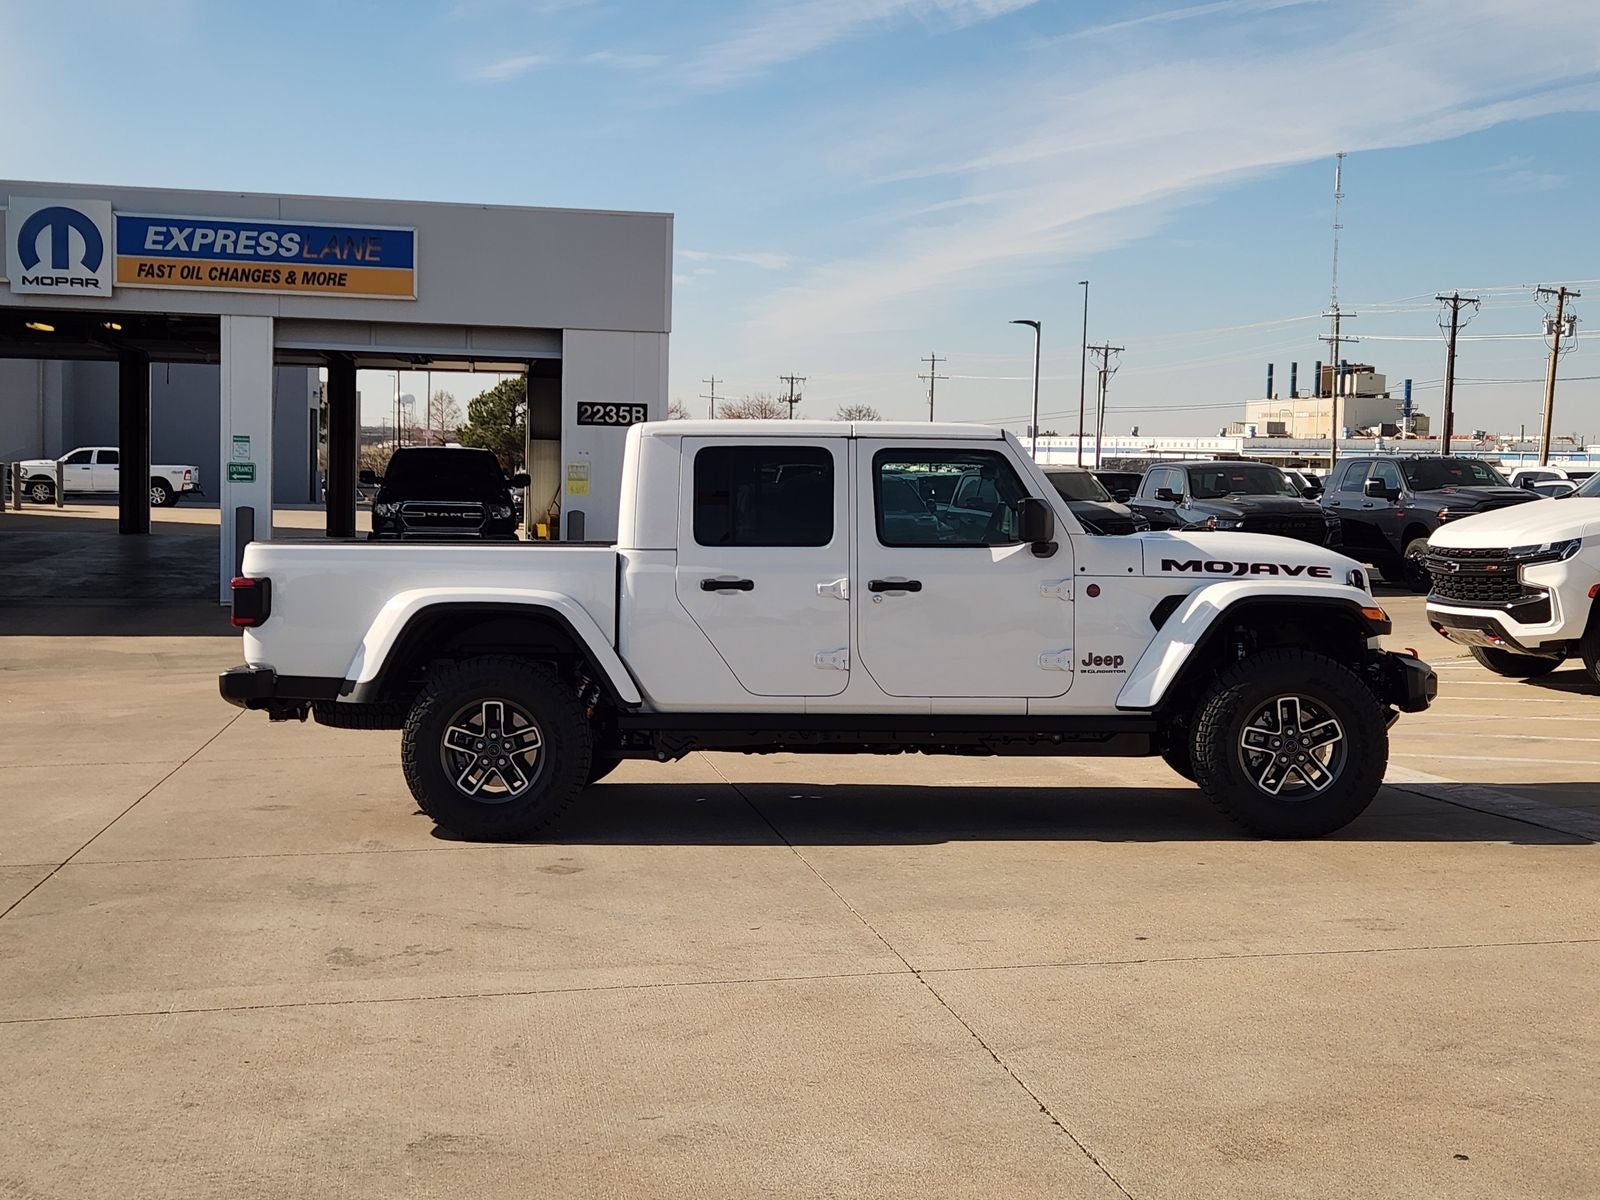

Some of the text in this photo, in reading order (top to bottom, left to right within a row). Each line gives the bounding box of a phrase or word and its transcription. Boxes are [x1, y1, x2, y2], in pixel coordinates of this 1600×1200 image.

[143, 226, 301, 258] EXPRESS
[21, 275, 101, 288] MOPAR
[137, 263, 348, 287] FAST OIL CHANGES & MORE
[580, 404, 645, 424] 2235B
[1161, 558, 1332, 578] MOJAVE
[1081, 652, 1124, 669] Jeep
